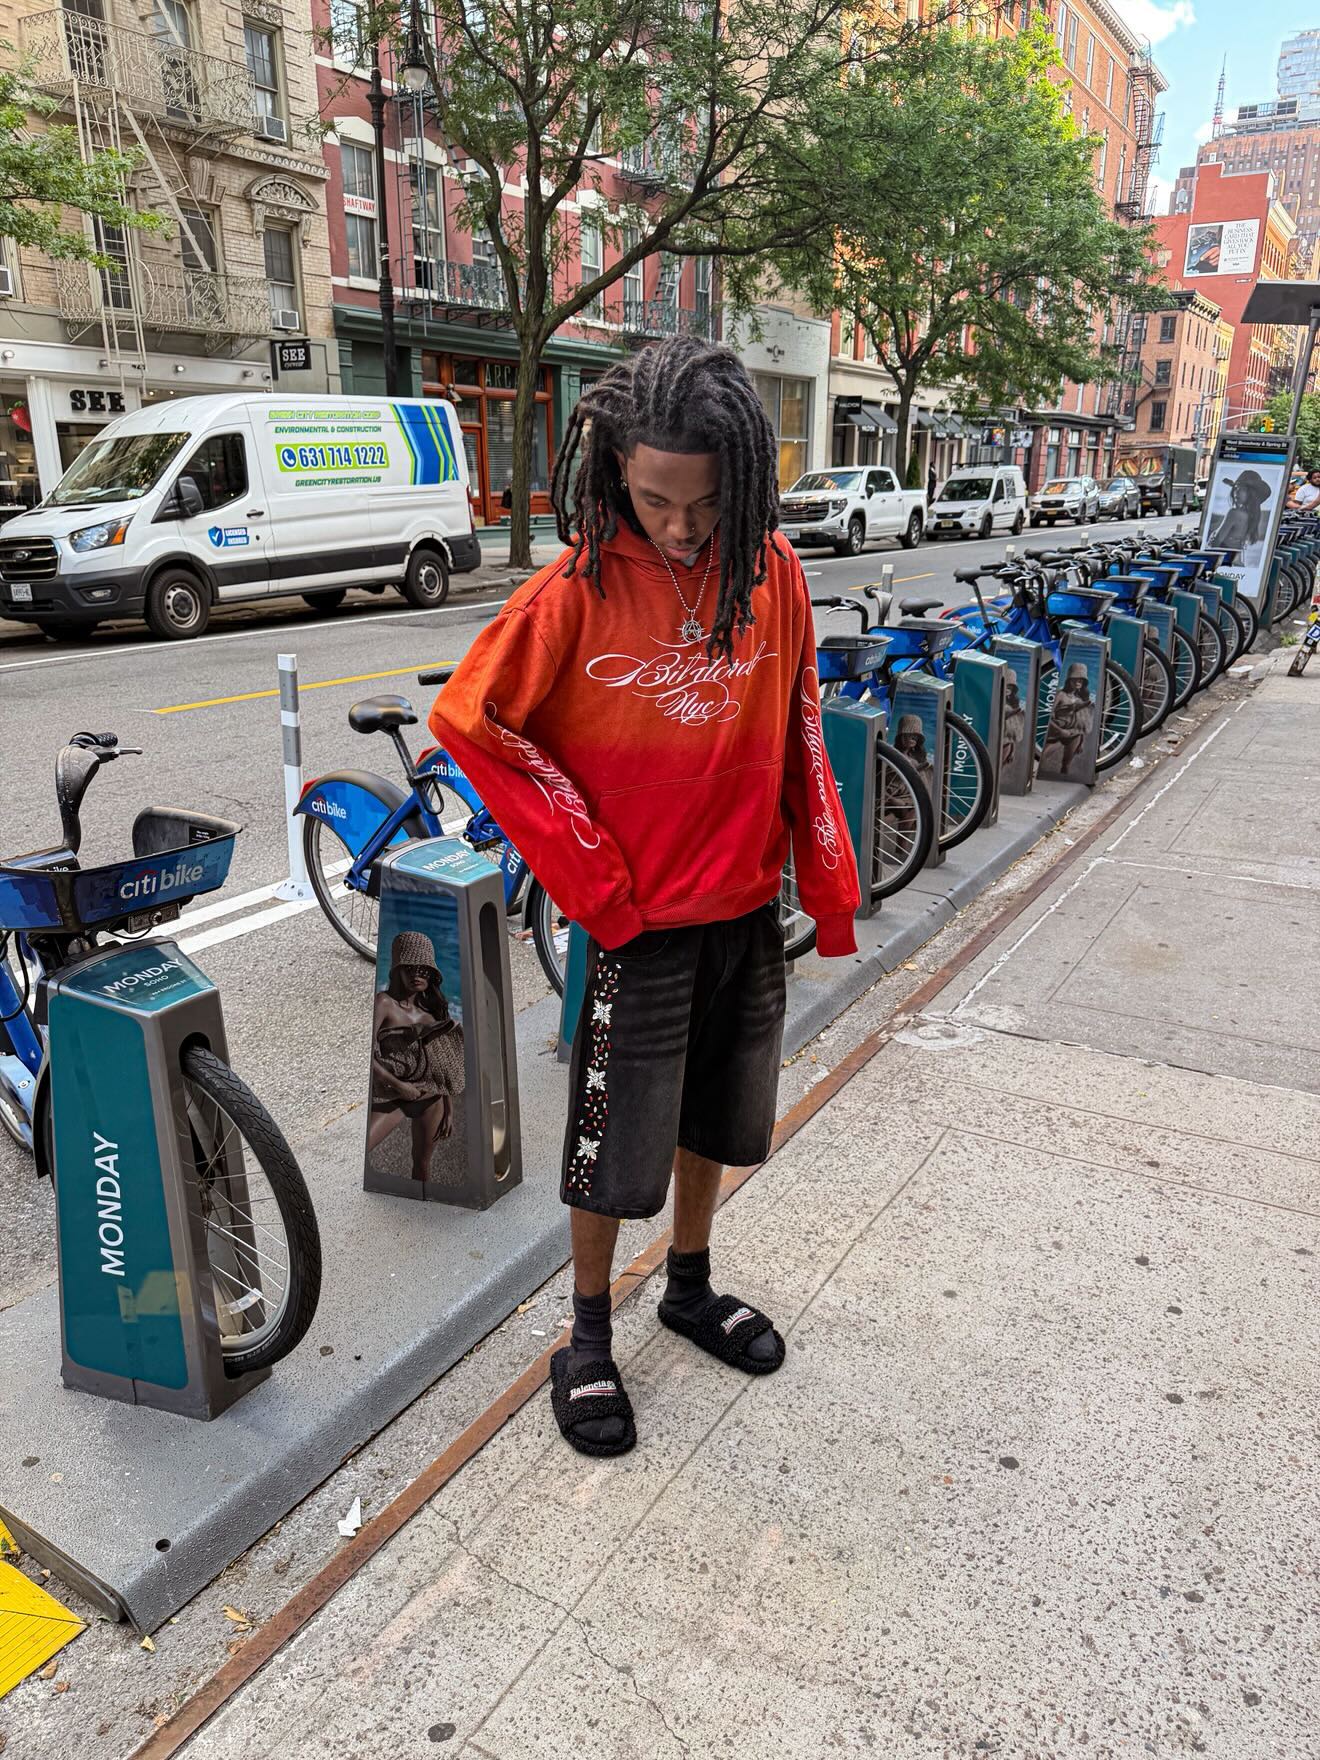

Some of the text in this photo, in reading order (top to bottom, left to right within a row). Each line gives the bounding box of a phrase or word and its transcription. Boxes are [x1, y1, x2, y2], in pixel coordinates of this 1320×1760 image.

[343, 197, 376, 212] SHAFTWAY
[282, 348, 305, 361] SEE
[69, 389, 126, 412] SEE
[275, 426, 329, 434] ENVIRONMENTAL
[298, 446, 386, 467] 631 714 1222
[295, 476, 382, 487] GREENCITYRESTORATION.US
[632, 680, 741, 726] Nyc
[953, 713, 973, 772] MONY
[431, 763, 465, 778] citi bik
[311, 800, 347, 819] citi bike
[422, 849, 471, 871] MONDAY
[120, 863, 204, 900] citi bike
[103, 958, 183, 993] MONDAY
[144, 975, 169, 987] SOHO
[93, 1131, 126, 1277] MONDAY
